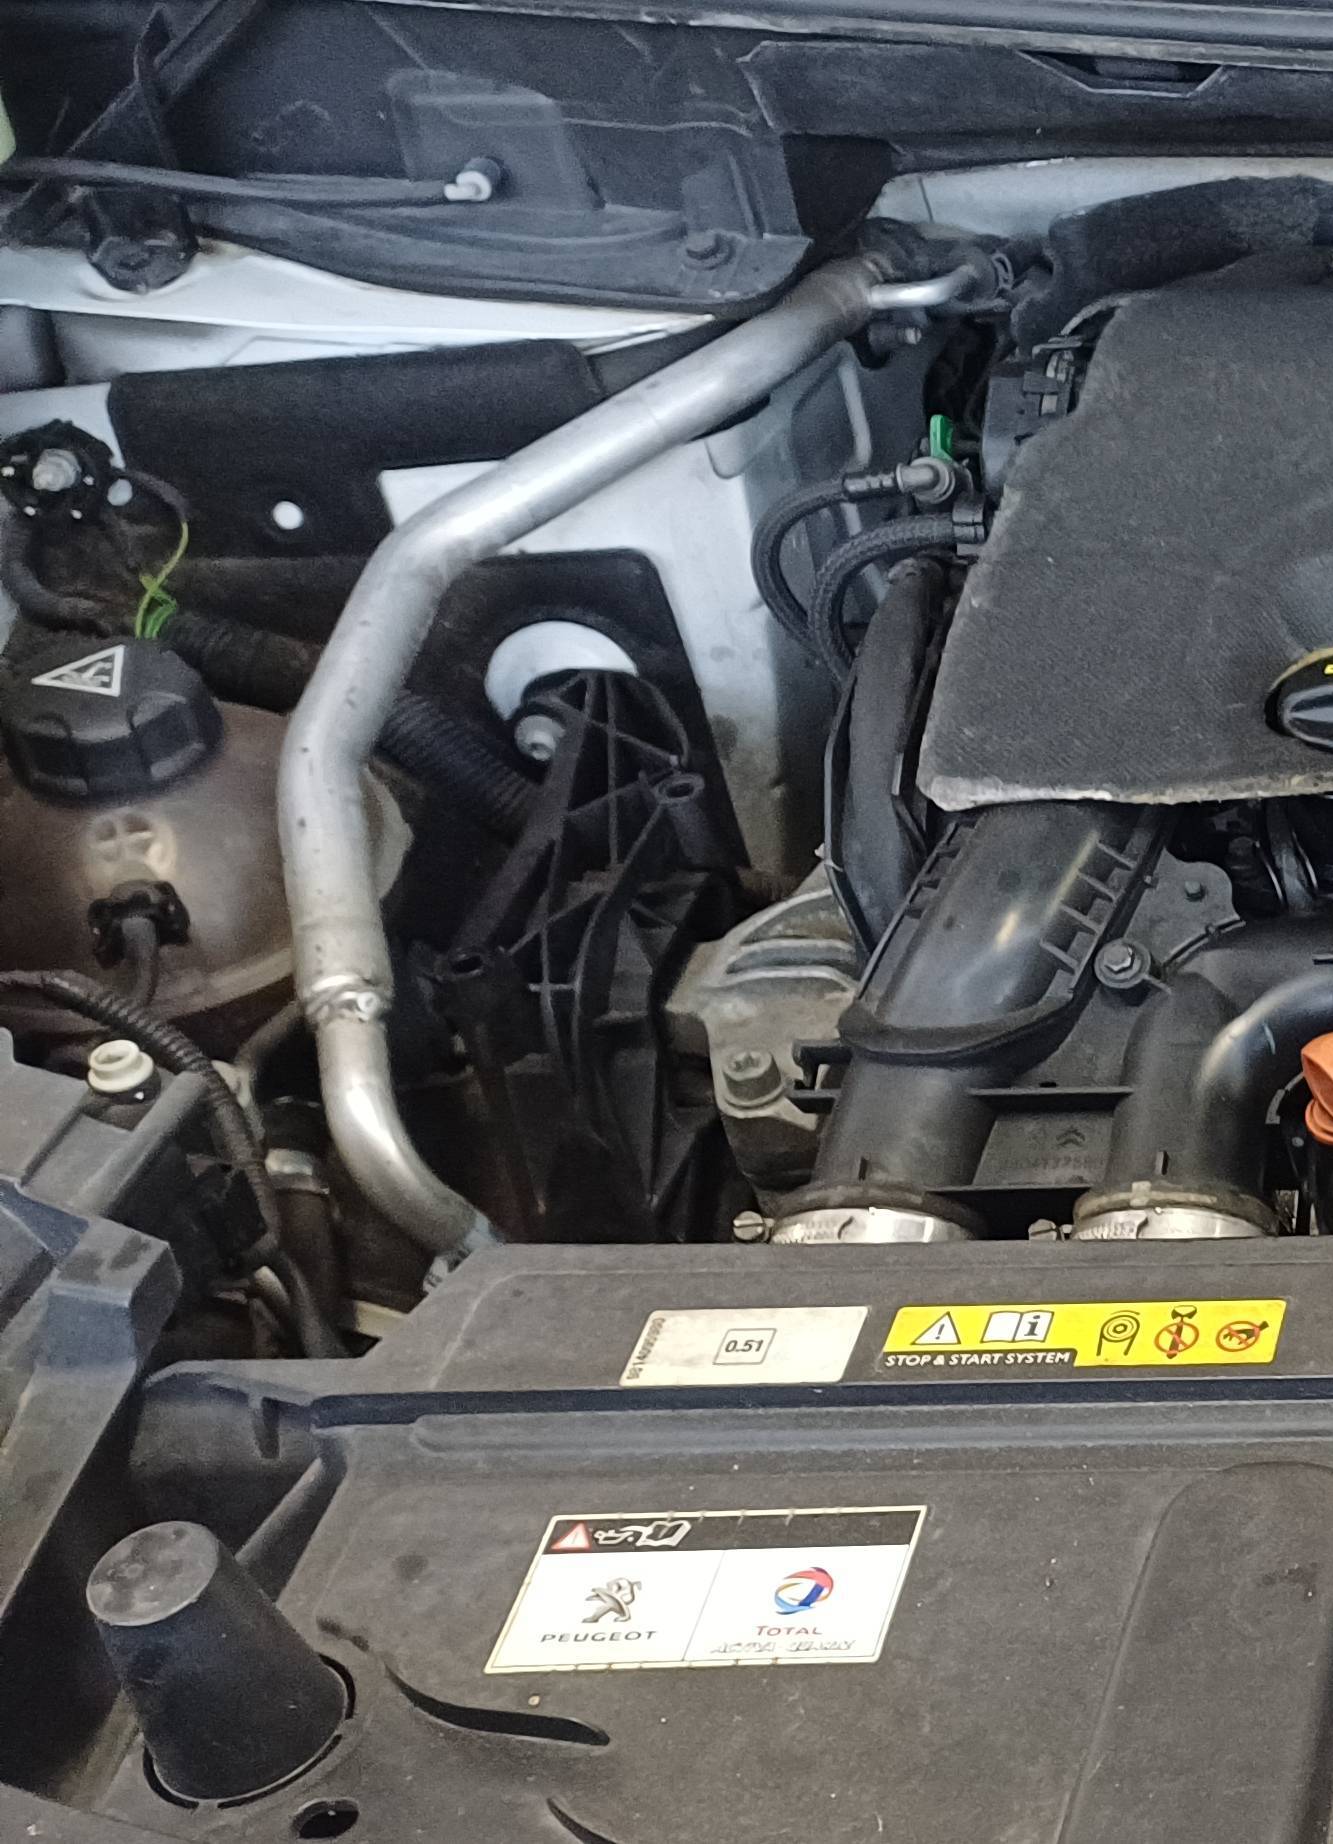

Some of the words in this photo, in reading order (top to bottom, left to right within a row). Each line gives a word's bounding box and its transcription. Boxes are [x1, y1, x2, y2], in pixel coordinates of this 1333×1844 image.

[725, 1339, 764, 1353] 0.51
[884, 1353, 931, 1367] STOP
[933, 1354, 945, 1366] &
[949, 1352, 1003, 1367] START
[1005, 1351, 1071, 1366] SYSTEM
[540, 1630, 657, 1643] PEUGEOT
[756, 1625, 823, 1637] TOTAL
